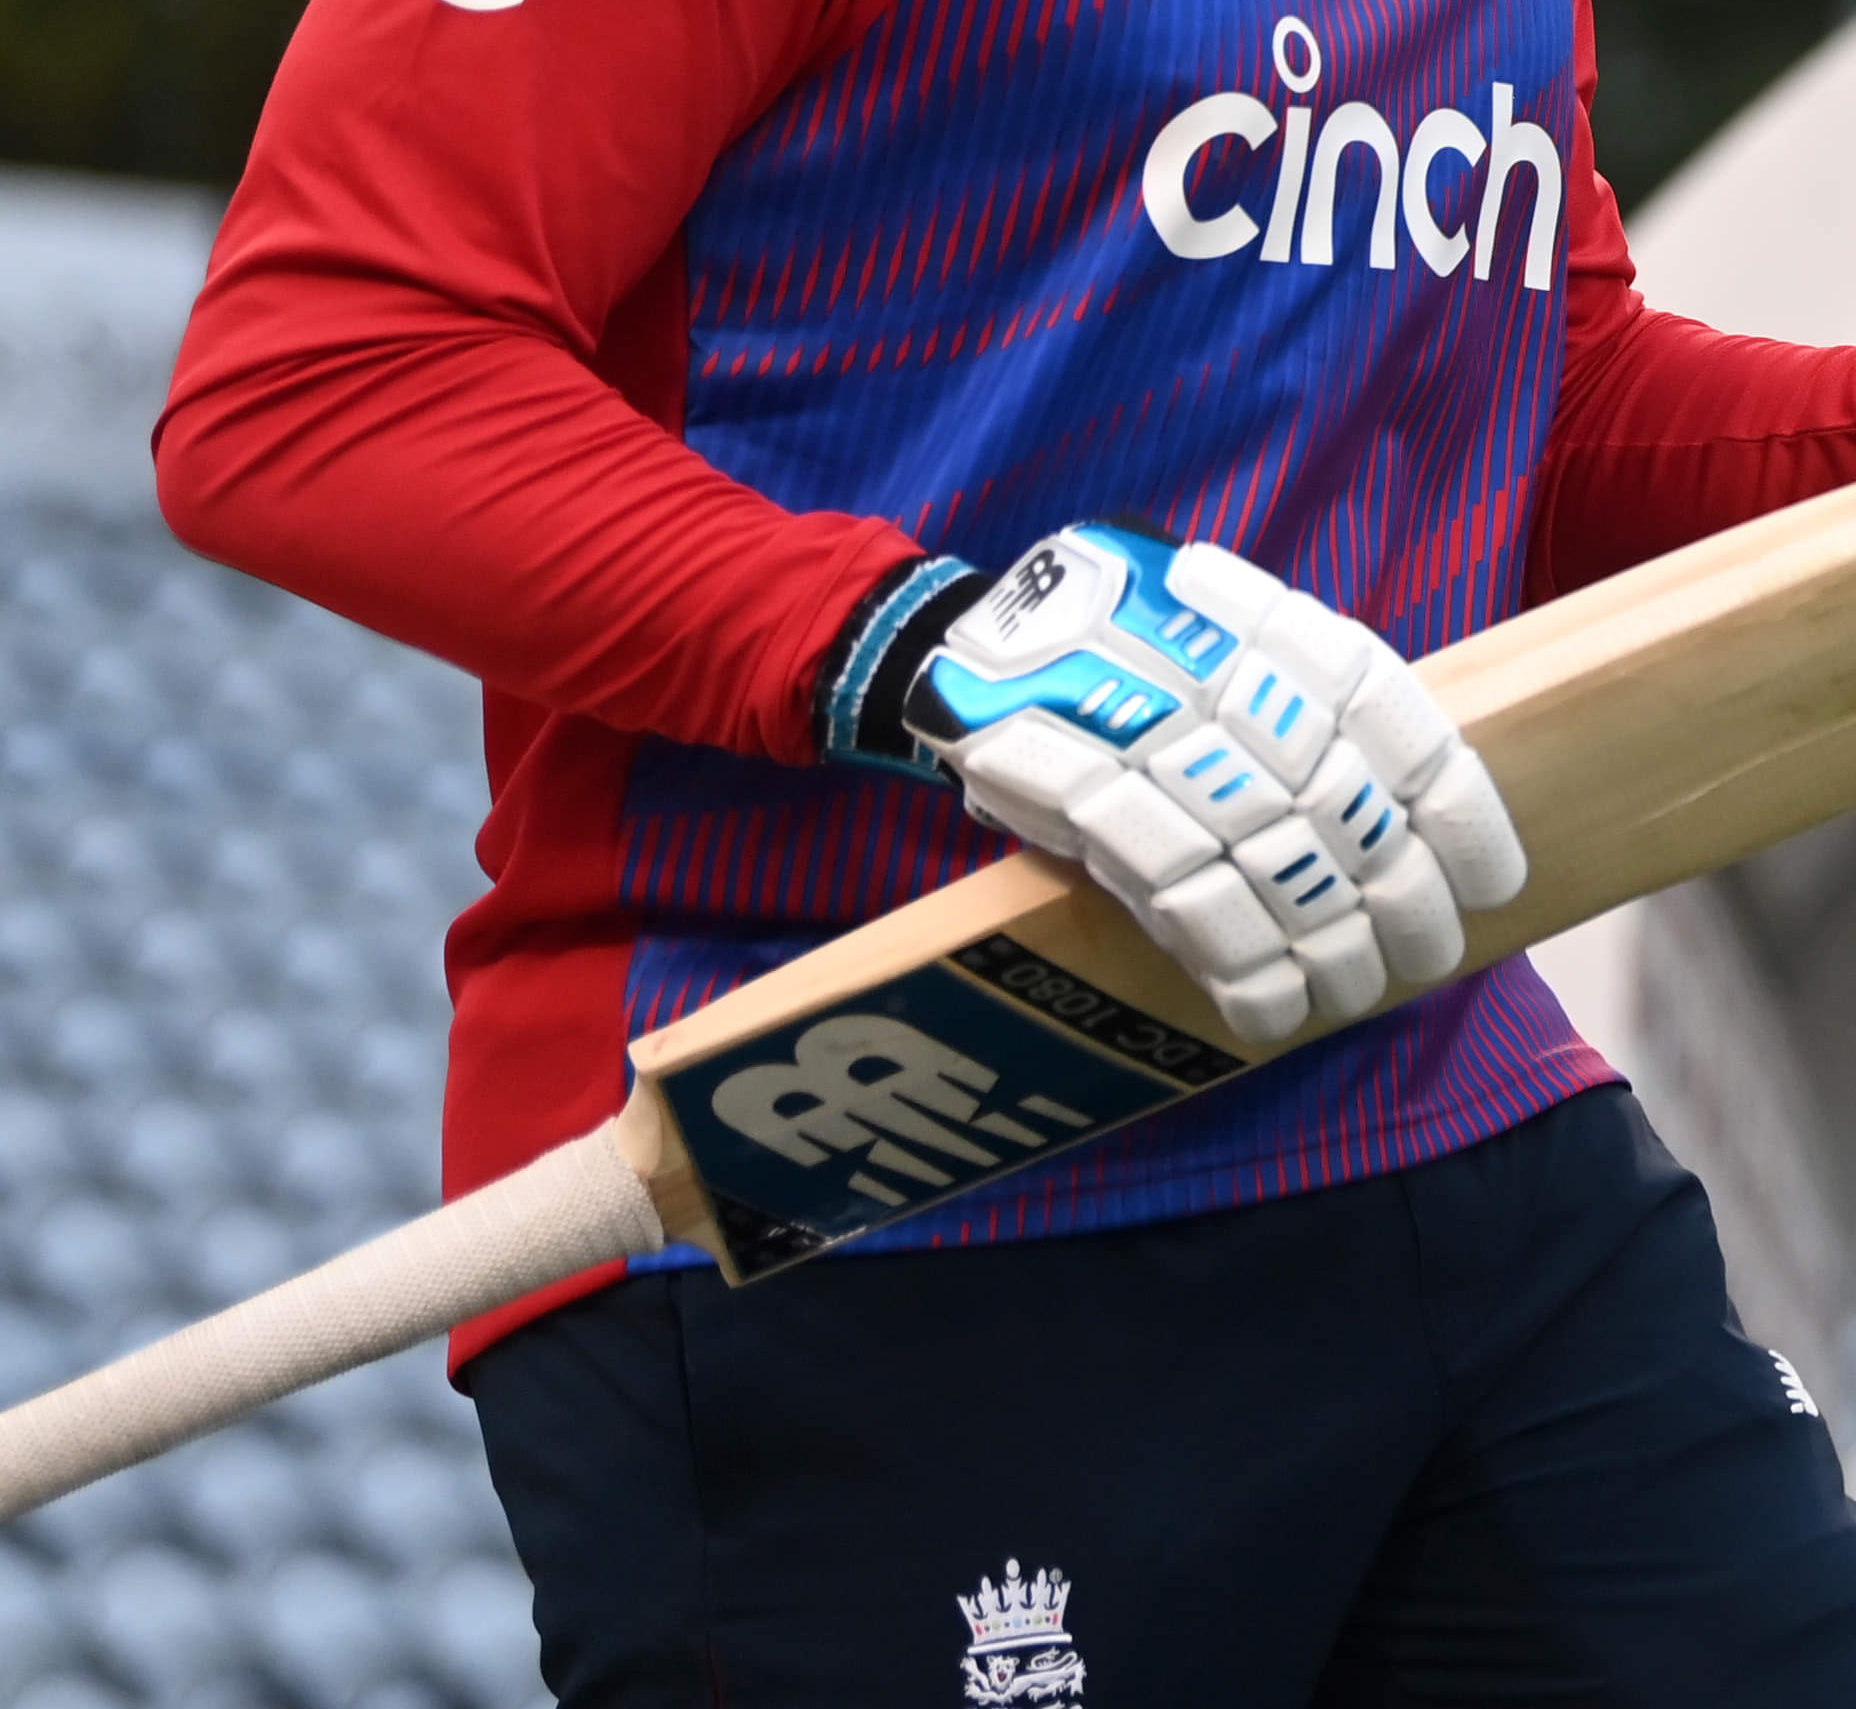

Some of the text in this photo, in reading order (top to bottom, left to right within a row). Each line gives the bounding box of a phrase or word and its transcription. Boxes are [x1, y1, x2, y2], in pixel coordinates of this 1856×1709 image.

[1141, 14, 1563, 292] cinch
[1001, 962, 1200, 1068] DC 1080
